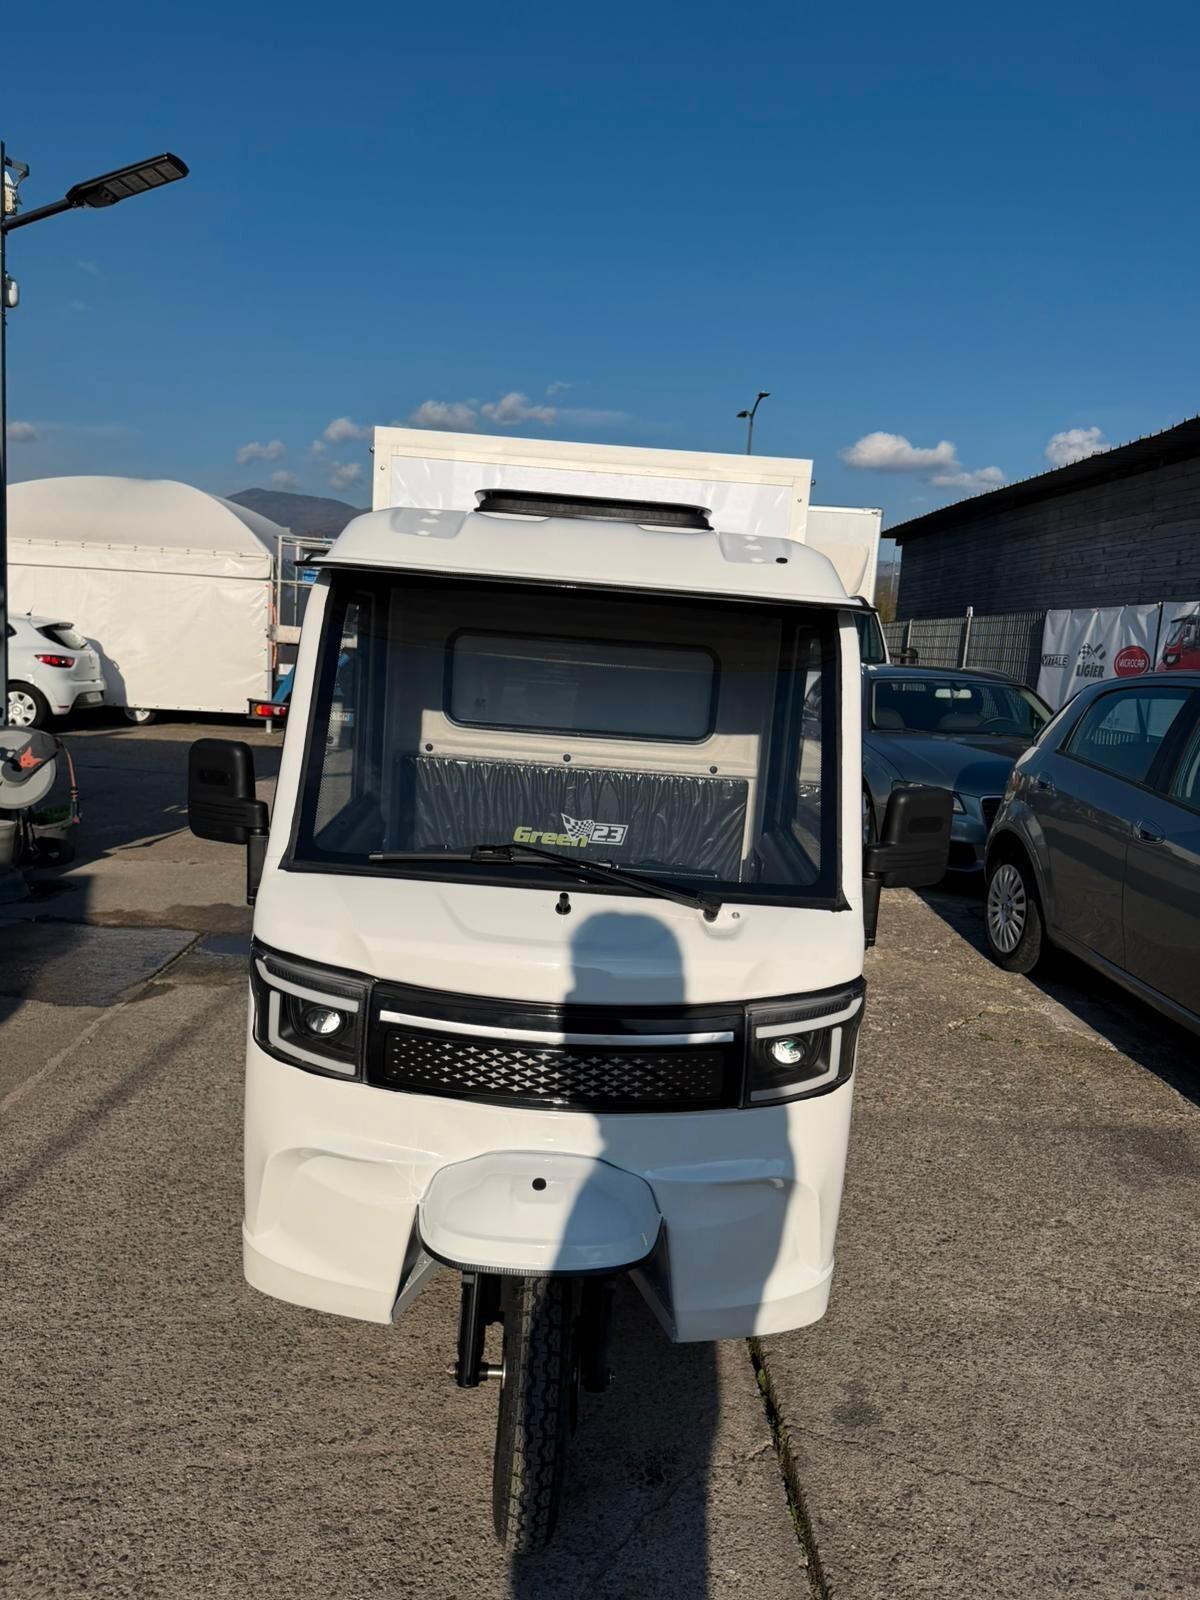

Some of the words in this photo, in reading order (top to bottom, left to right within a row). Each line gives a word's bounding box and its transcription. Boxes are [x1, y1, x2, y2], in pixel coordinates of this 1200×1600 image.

[1076, 662, 1105, 678] LIGIER
[513, 826, 589, 848] Green
[591, 825, 624, 843] 23
